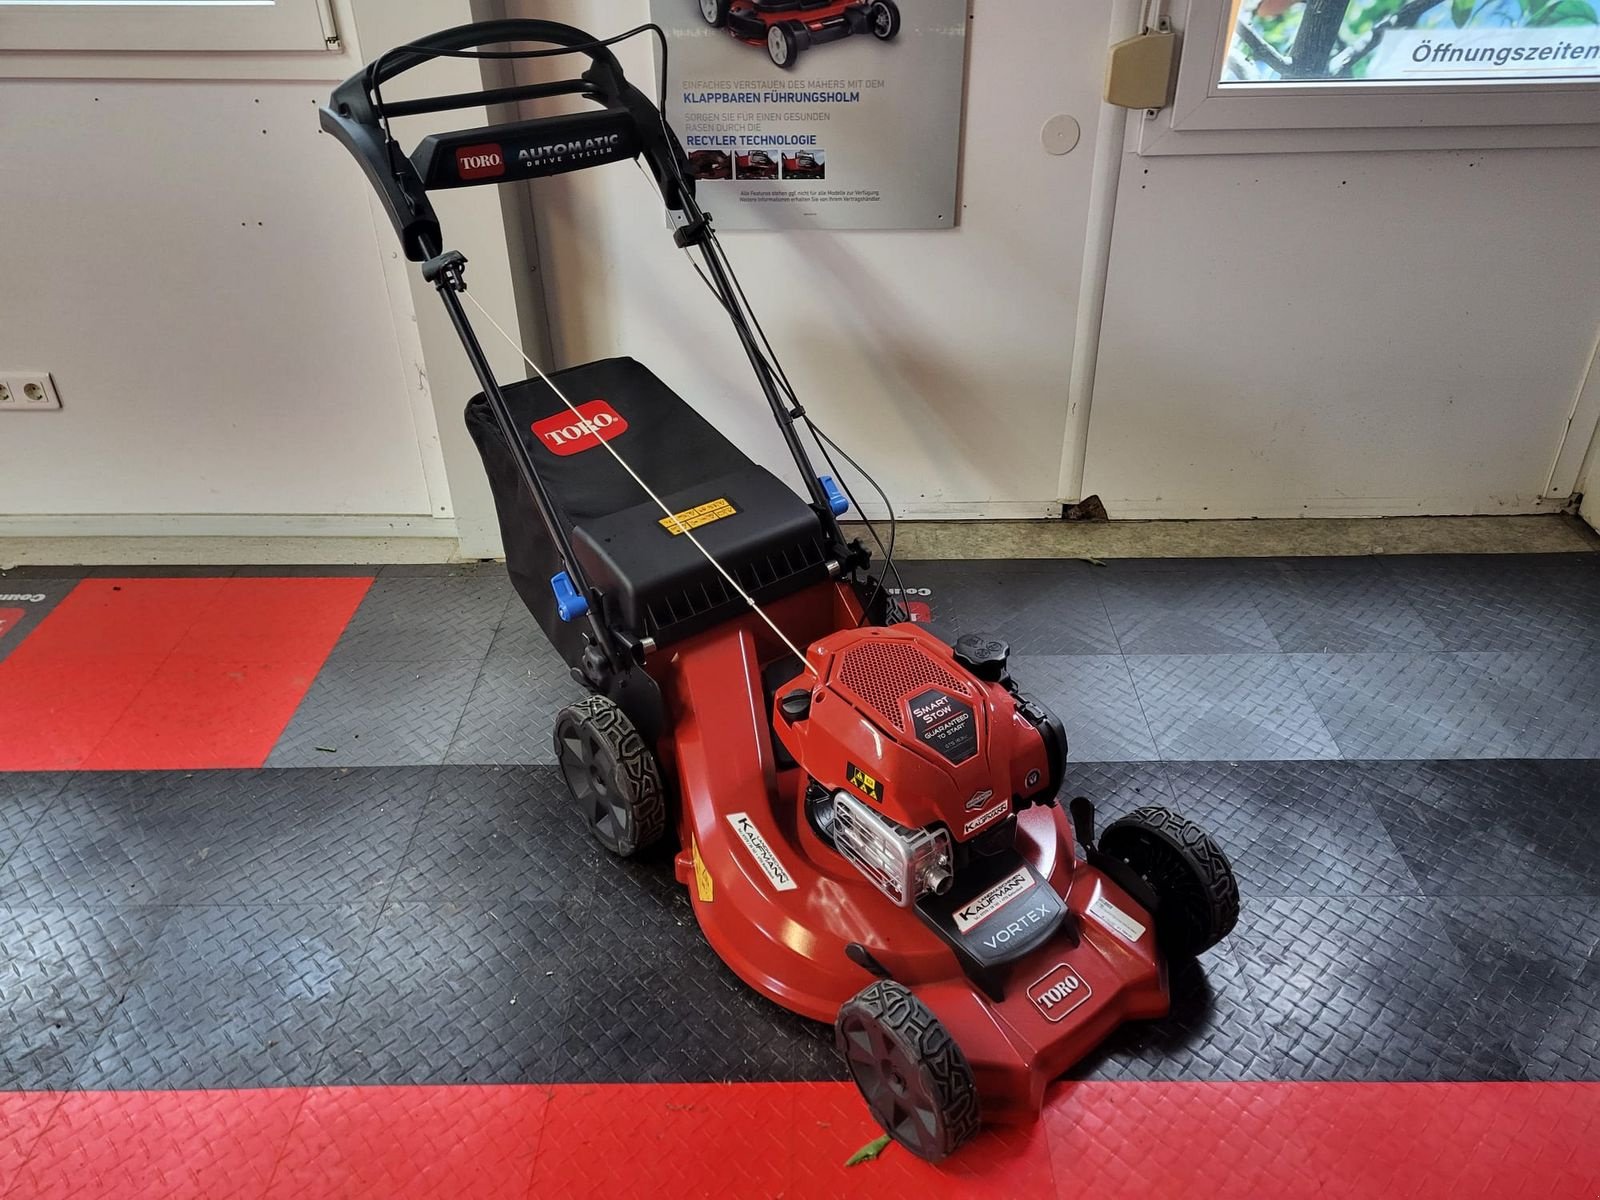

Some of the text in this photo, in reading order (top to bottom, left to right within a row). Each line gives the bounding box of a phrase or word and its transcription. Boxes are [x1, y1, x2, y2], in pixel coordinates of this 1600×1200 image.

[682, 80, 732, 90] EINFACHES
[732, 80, 786, 90] VERSTAUEN
[787, 80, 806, 89] DES
[847, 79, 864, 88] MIT
[865, 79, 885, 88] DEM
[683, 90, 860, 103] KLAPPBAREN FÜHRUNGSHOLM
[684, 111, 831, 121] SORGEN SIE FÜR EINEN GESUNDEN
[685, 123, 762, 132] RASEN DURCH DIE
[518, 134, 619, 160] AUTOMATIC
[686, 135, 817, 145] RECYLER TECHNOLOGIE
[460, 153, 500, 170] TORO
[526, 147, 613, 167] DRIVE SYSTEM
[544, 413, 613, 446] TORO
[913, 696, 949, 717] SMART
[923, 706, 952, 724] STOW
[924, 713, 969, 740] GUARANTEED
[946, 722, 966, 736] START
[983, 903, 1051, 949] VORTEX
[1037, 975, 1080, 1009] TORO
